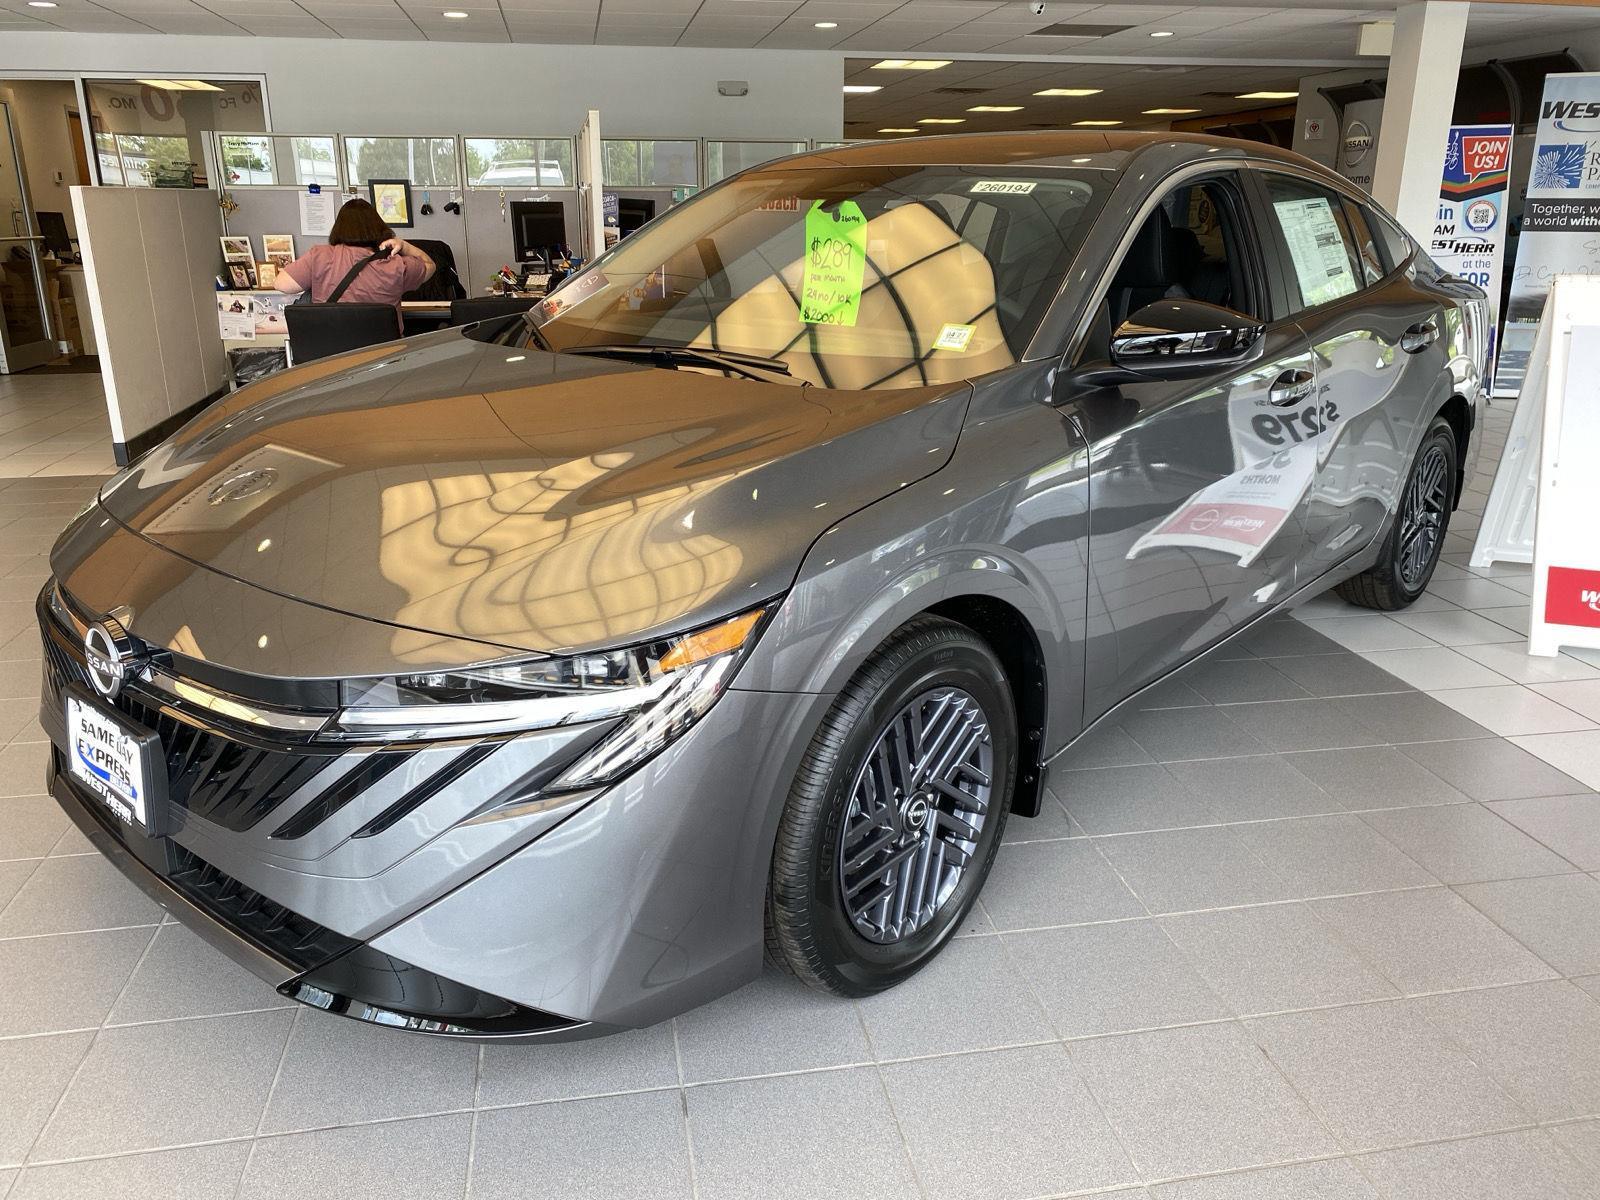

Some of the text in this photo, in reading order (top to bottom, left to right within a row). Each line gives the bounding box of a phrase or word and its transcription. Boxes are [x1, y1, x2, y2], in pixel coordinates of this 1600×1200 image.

[1468, 141, 1507, 155] JOIN
[1474, 155, 1500, 169] US!
[1437, 204, 1454, 220] in
[1532, 203, 1586, 216] Together,
[1523, 217, 1531, 226] a
[1534, 216, 1568, 226] world
[811, 237, 853, 270] $289
[1462, 260, 1492, 269] at the
[81, 718, 115, 749] SAME
[79, 738, 131, 787] EXPRESS
